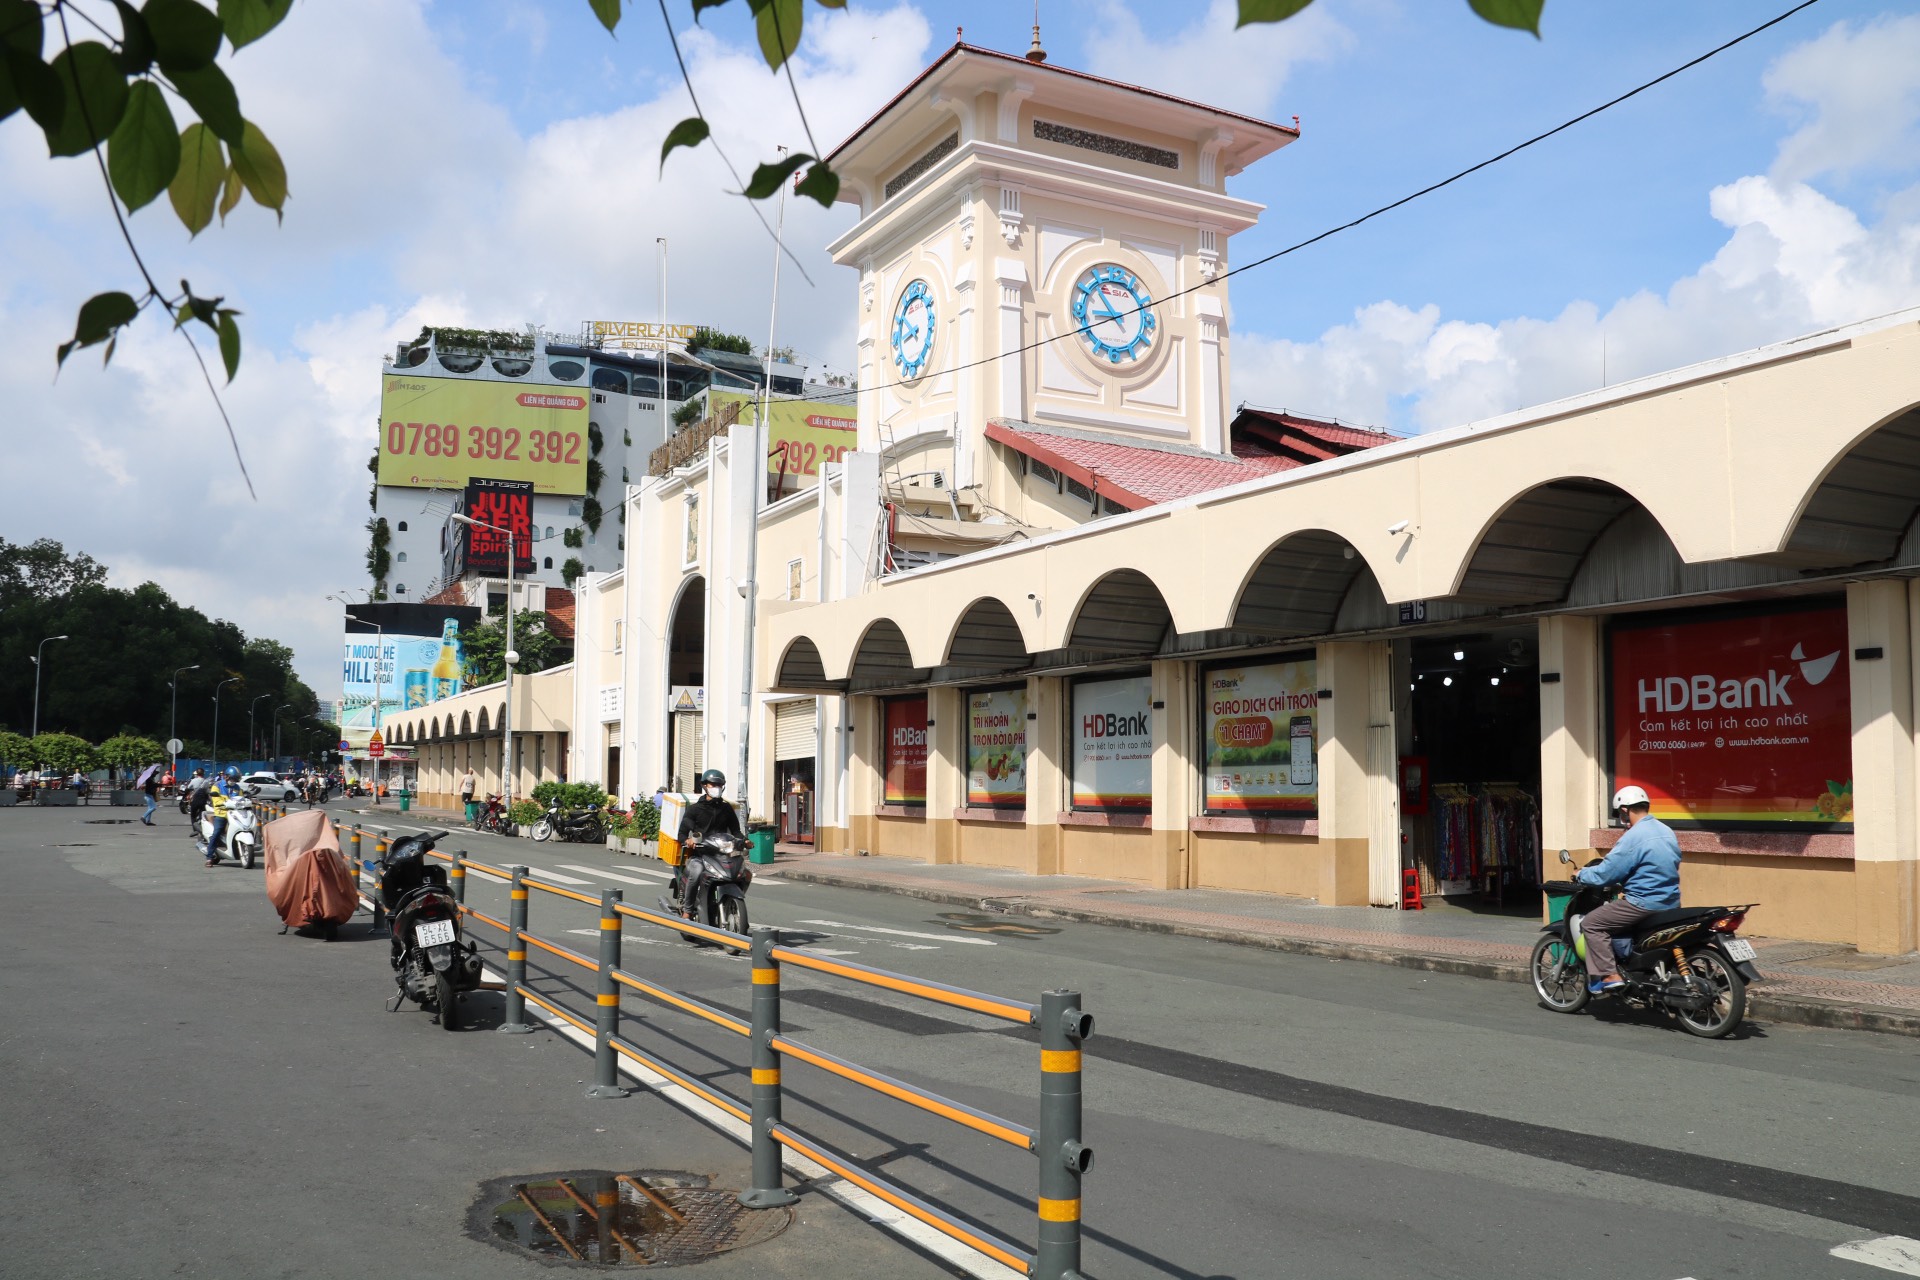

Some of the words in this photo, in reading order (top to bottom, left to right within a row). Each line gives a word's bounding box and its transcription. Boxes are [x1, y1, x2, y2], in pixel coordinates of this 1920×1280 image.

[1107, 266, 1126, 284] 12
[593, 321, 697, 339] SILVERLAND
[524, 395, 537, 405] LIÊN
[537, 396, 546, 407] HỆ
[546, 396, 566, 407] QUẢNG
[566, 397, 579, 408] CÁO
[387, 421, 460, 458] 0789
[467, 425, 522, 461] 392
[528, 429, 582, 465] 392
[775, 438, 817, 475] 392
[1412, 600, 1424, 620] 16
[352, 644, 380, 660] MOOD
[383, 643, 396, 660] HÈ
[1212, 678, 1239, 689] HDBank
[1637, 669, 1793, 713] HDBank
[1213, 699, 1241, 715] GIAO
[1242, 697, 1266, 717] DỊCH
[1268, 690, 1285, 712] CHỈ
[973, 713, 983, 729] TÀI
[984, 710, 1009, 728] KHOẢN
[1083, 711, 1148, 738] HDBank
[1639, 719, 1664, 732] Cam
[1671, 718, 1691, 731] kết
[1697, 717, 1713, 732] lợi
[1720, 715, 1738, 729] ích
[1745, 717, 1769, 728] cao
[1776, 713, 1809, 727] nhất
[1083, 742, 1095, 751] Cam
[1096, 741, 1106, 751] kết
[1648, 741, 1667, 750] 1900
[1667, 740, 1687, 750] 6060
[1728, 736, 1809, 748] www.hdbank.com.vn
[422, 923, 447, 936] 54-X2
[424, 932, 449, 945] 6566
